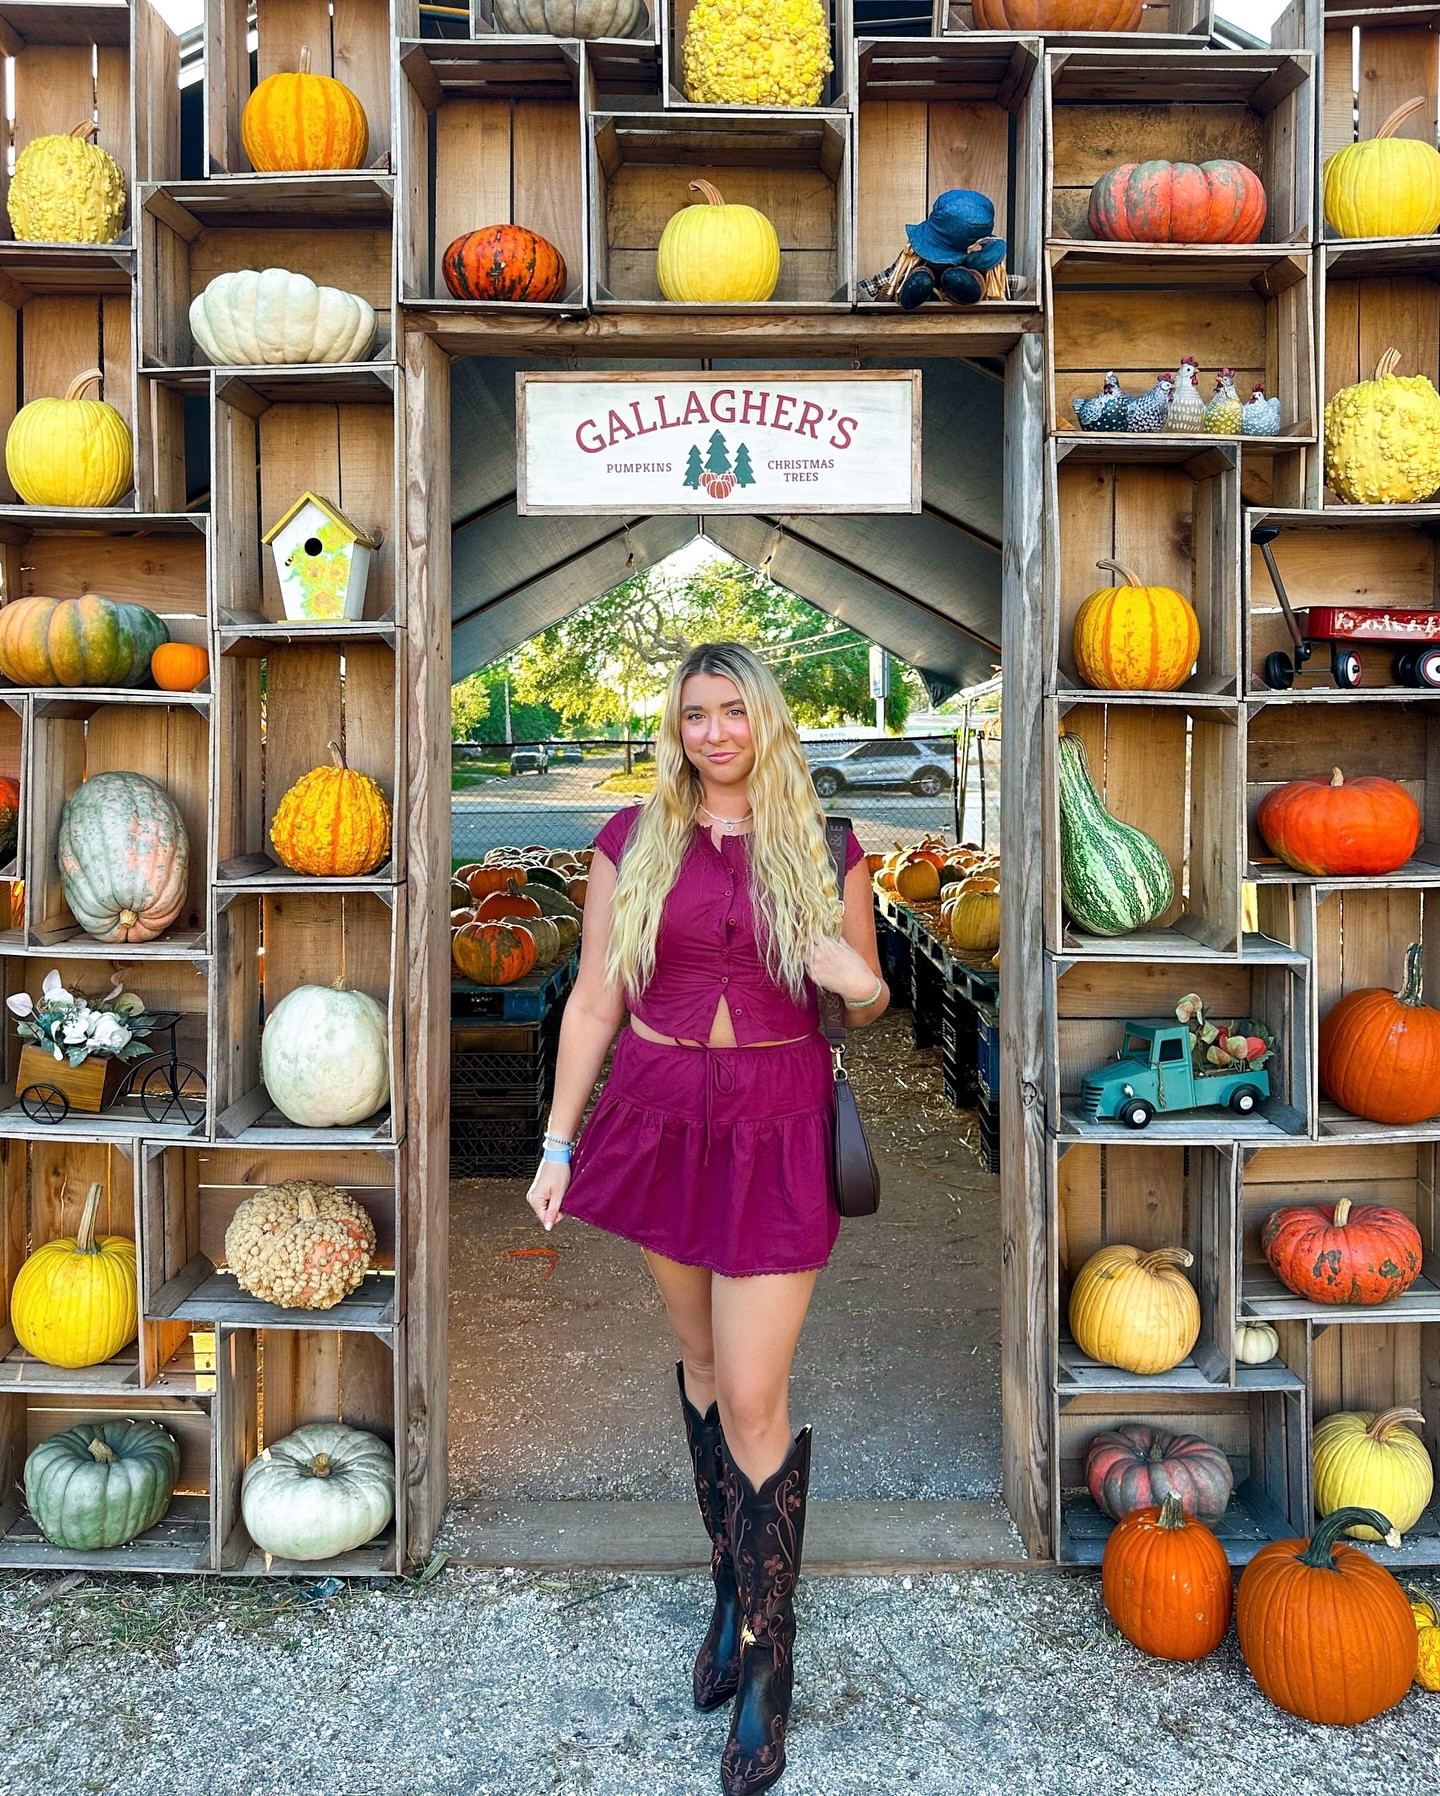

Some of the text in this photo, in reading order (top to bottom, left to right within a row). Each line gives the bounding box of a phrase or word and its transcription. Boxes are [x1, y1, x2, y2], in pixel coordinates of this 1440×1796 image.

[576, 389, 858, 453] GALLAGHER'S
[606, 463, 672, 474] PUMPKINS
[767, 460, 834, 470] CHRISTMAS
[783, 472, 819, 482] TREES
